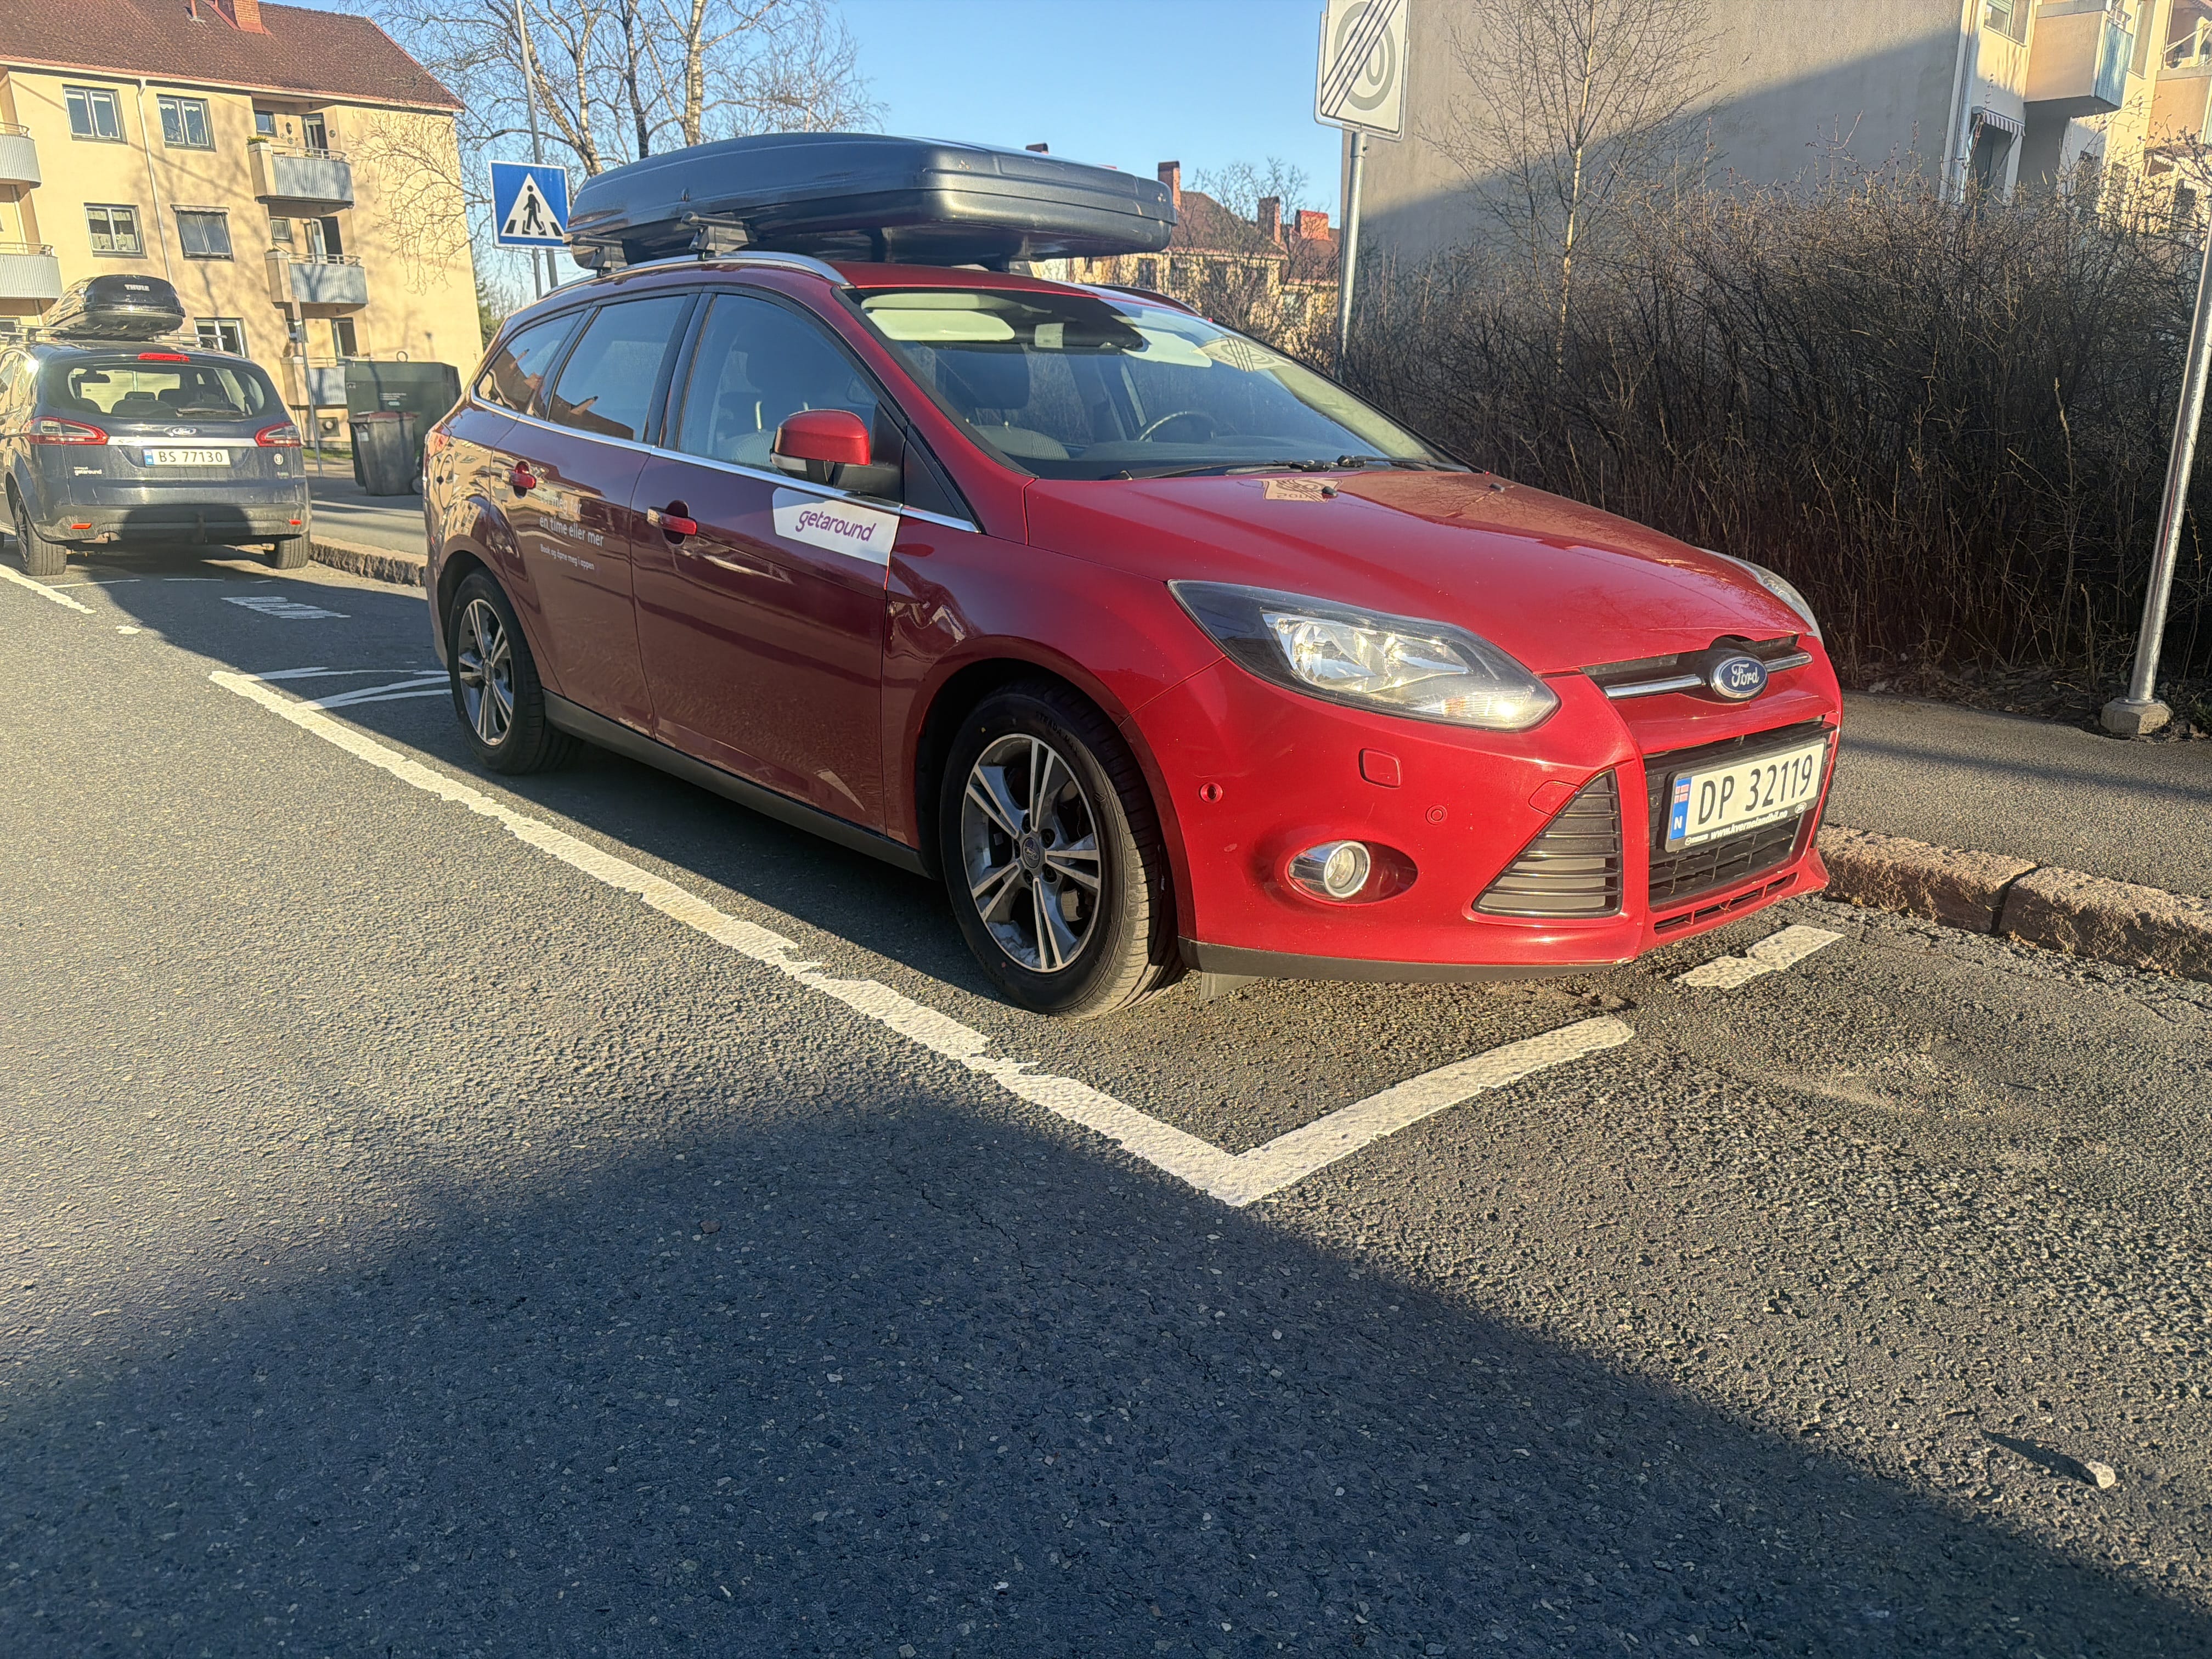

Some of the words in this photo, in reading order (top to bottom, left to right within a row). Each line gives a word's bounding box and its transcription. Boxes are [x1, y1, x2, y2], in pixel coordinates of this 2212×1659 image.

[159, 452, 176, 462] BS
[182, 452, 223, 462] 77130
[540, 516, 548, 528] en
[550, 516, 567, 535] time
[569, 523, 585, 540] eller
[588, 531, 603, 546] mer
[795, 510, 877, 541] getaround
[1731, 663, 1759, 687] Ford
[1698, 776, 1734, 825] DP
[1745, 754, 1813, 811] 32119
[1674, 816, 1683, 830] N
[1711, 810, 1788, 840] www.kvernelandbil.no
